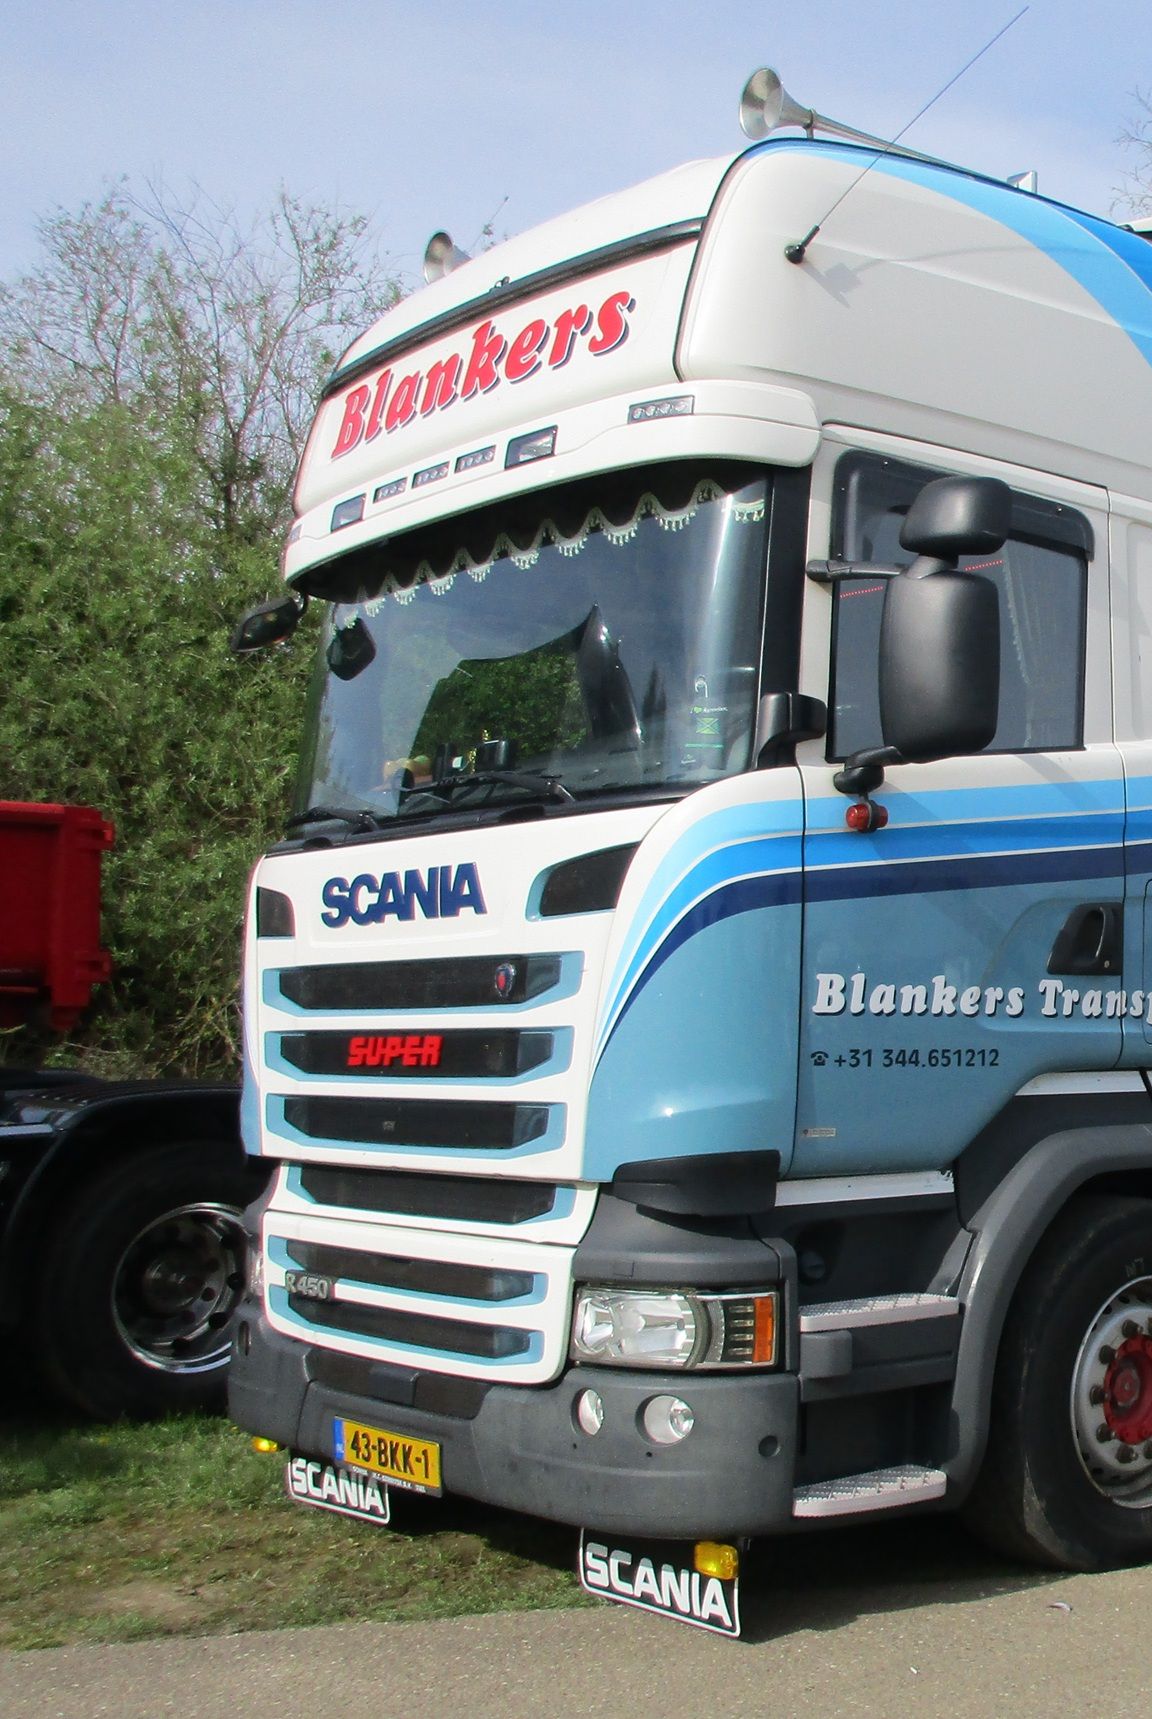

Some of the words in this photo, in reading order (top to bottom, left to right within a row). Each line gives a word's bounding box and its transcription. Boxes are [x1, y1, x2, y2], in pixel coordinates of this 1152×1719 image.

[331, 291, 635, 460] Blankers
[321, 861, 488, 928] SCANIA
[812, 972, 1025, 1018] Blankers
[347, 1035, 443, 1067] SUPER
[834, 1048, 872, 1068] +31
[882, 1047, 1000, 1068] 344.651212
[350, 1430, 430, 1479] 43-BKK-1
[292, 1457, 385, 1515] SCANIA
[586, 1542, 733, 1628] SCANIA
